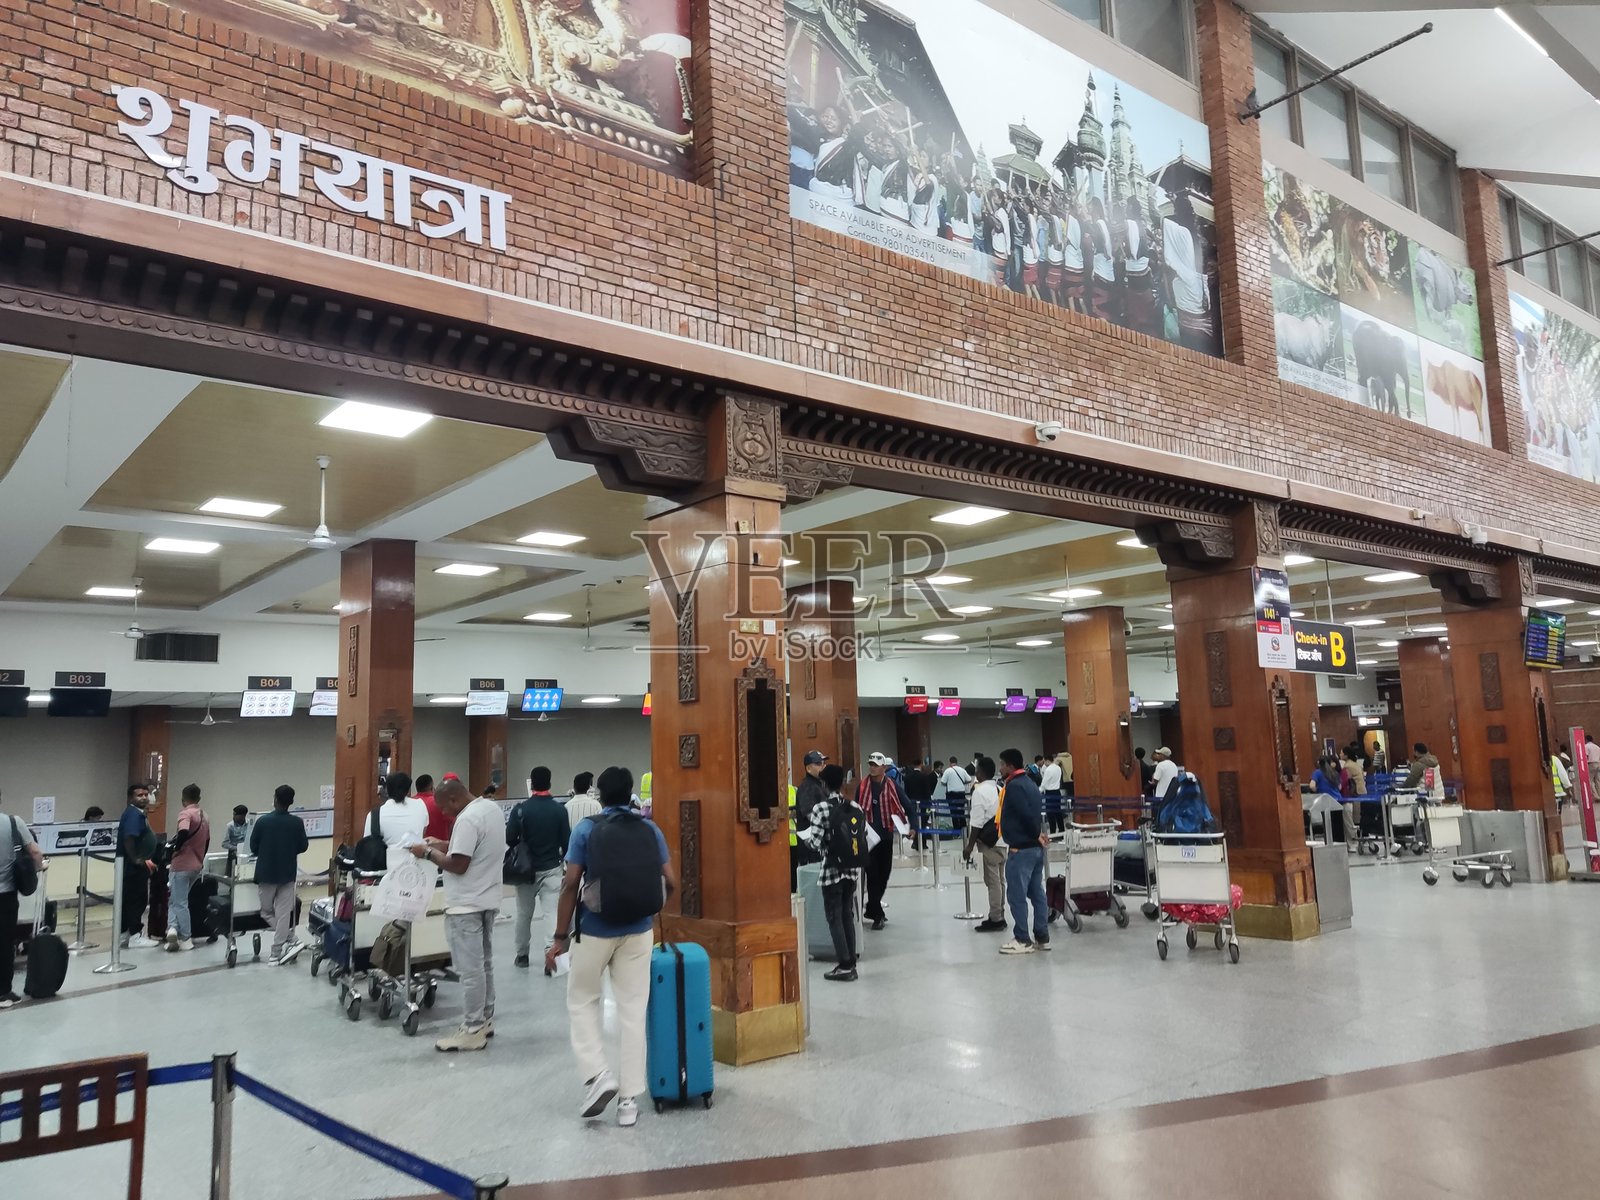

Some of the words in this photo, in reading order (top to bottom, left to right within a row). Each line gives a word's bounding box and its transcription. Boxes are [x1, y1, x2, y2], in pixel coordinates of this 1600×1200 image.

[111, 84, 513, 252] शुभयात्रा
[808, 199, 838, 218] SPACE
[840, 210, 885, 234] AVAILABLE
[886, 225, 904, 240] FOR
[905, 234, 966, 262] ADVERTISEMENT
[846, 225, 880, 245] Contact:
[882, 236, 935, 263] 9801035416
[1295, 631, 1328, 646] Check-in
[1329, 631, 1347, 667] B
[0, 672, 10, 682] 2
[69, 674, 92, 684] B03
[260, 678, 280, 688] B04
[479, 680, 496, 689] B06
[534, 681, 549, 689] B07
